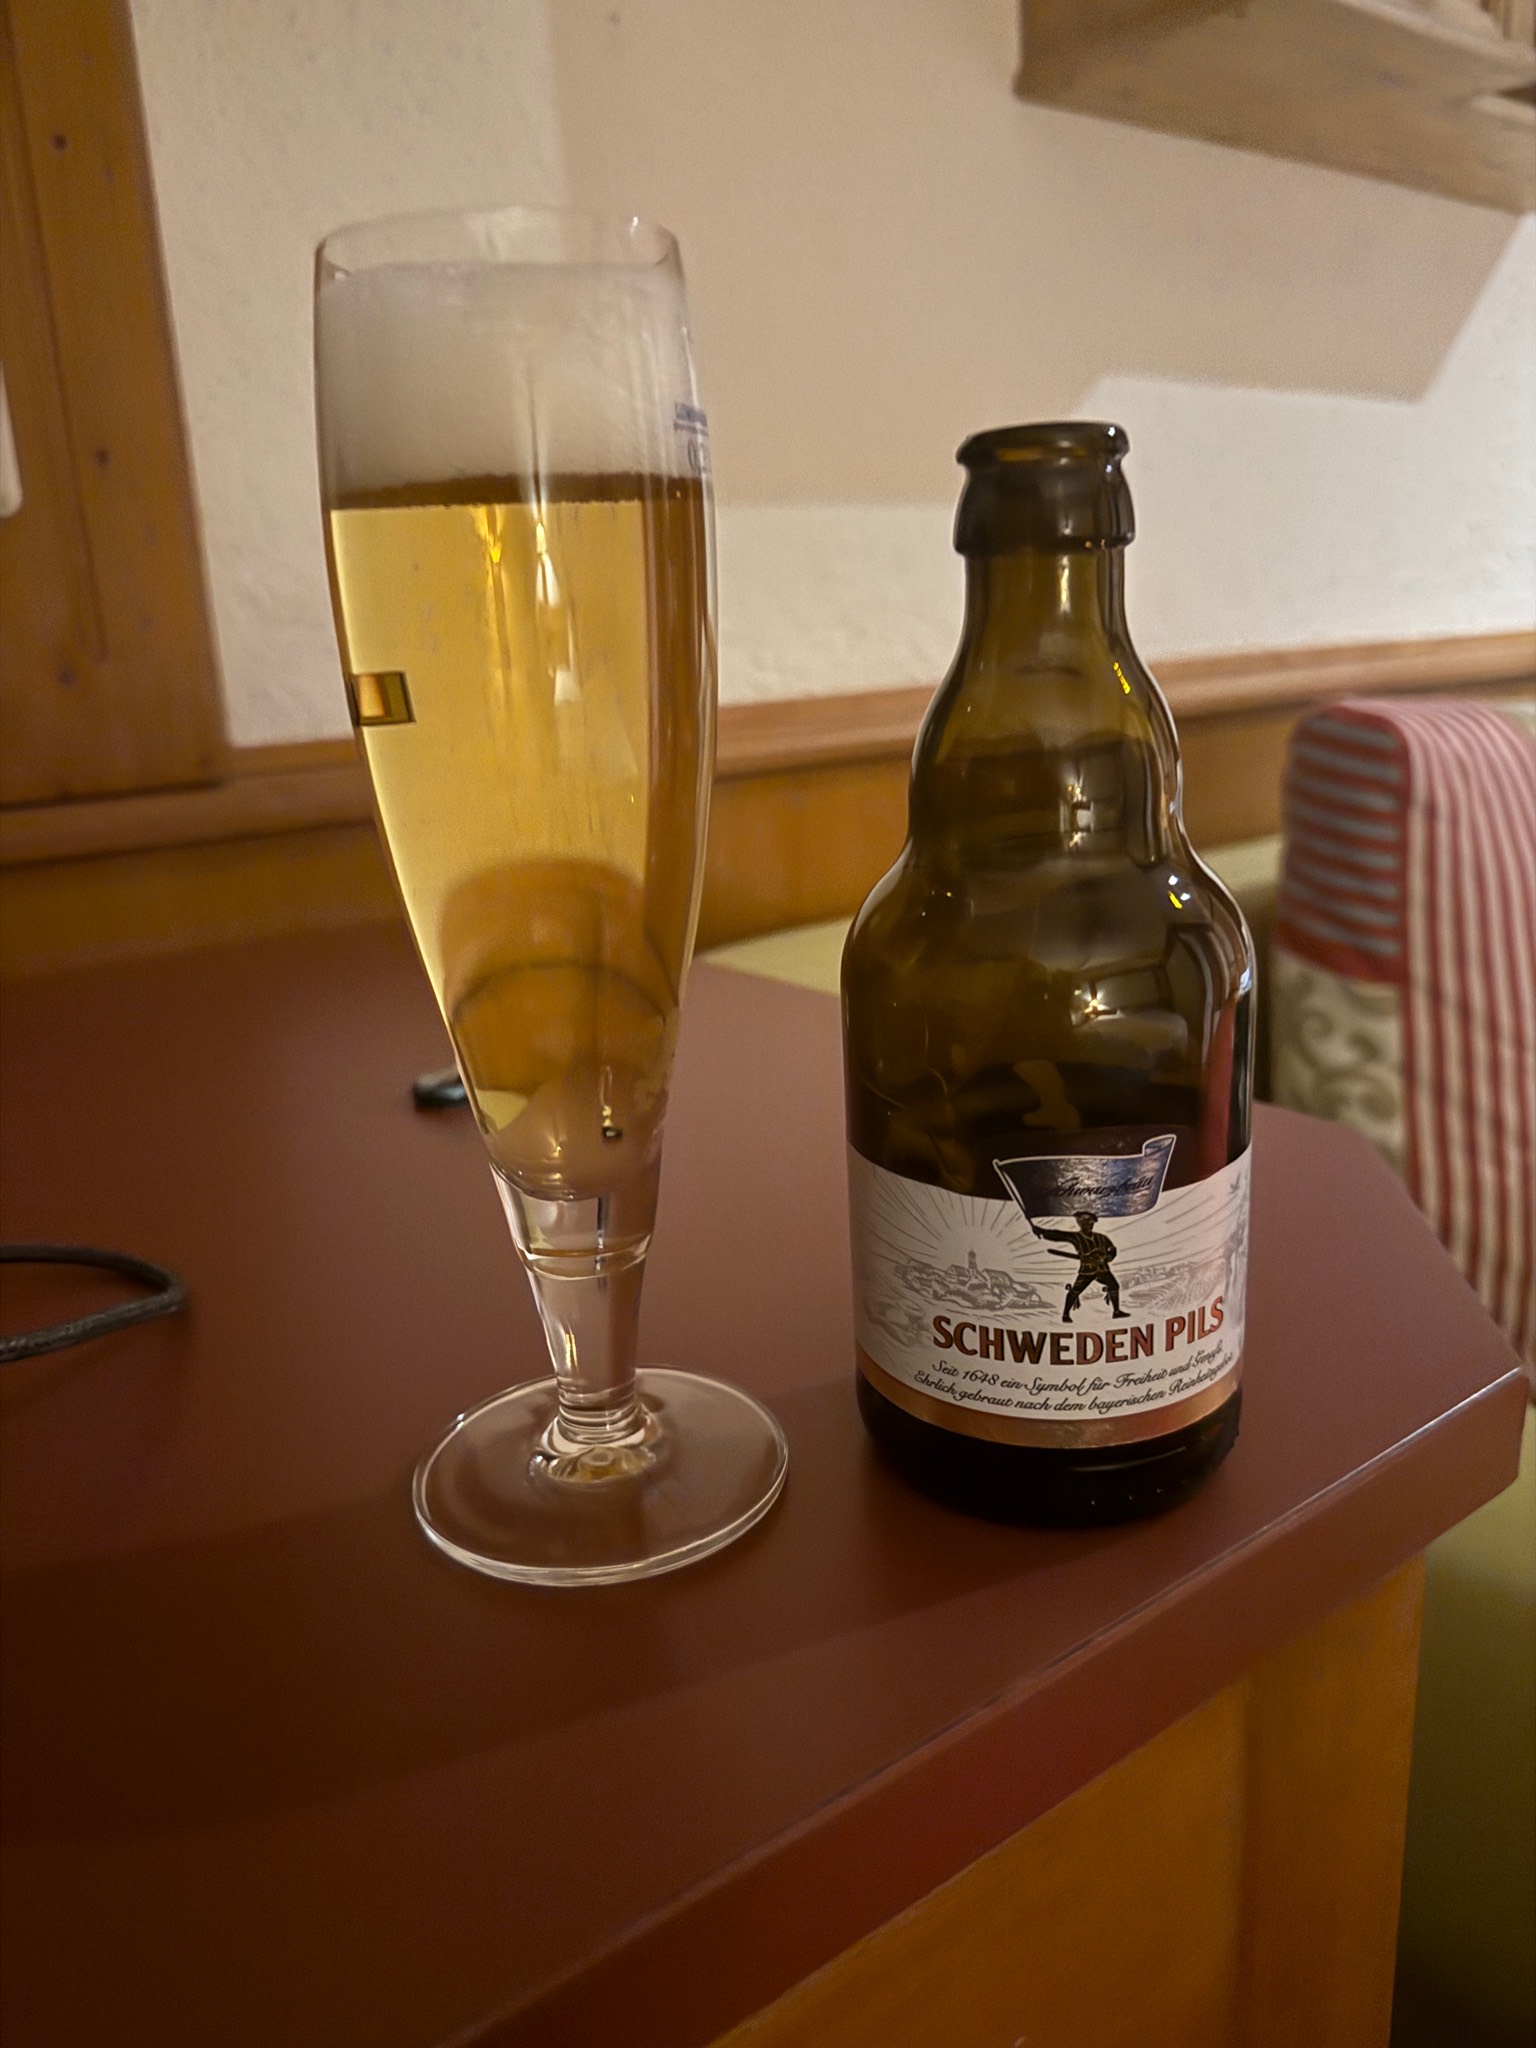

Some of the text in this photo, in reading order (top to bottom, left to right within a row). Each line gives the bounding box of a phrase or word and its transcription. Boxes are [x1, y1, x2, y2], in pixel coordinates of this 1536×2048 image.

[933, 1296, 1224, 1366] SCHWEDEN PILS
[914, 1370, 959, 1396] Ehrlich
[953, 1390, 1014, 1409] gebraut
[1014, 1396, 1054, 1411] nach
[1053, 1398, 1085, 1411] dem
[1088, 1387, 1166, 1414] bayerischen
[932, 1360, 959, 1377] Seit
[962, 1370, 1000, 1386] 1648
[1001, 1378, 1024, 1390] ein
[1024, 1376, 1087, 1397] Symbol
[1085, 1377, 1111, 1396] für
[1114, 1369, 1168, 1390] Freiheit
[1168, 1356, 1194, 1377] und
